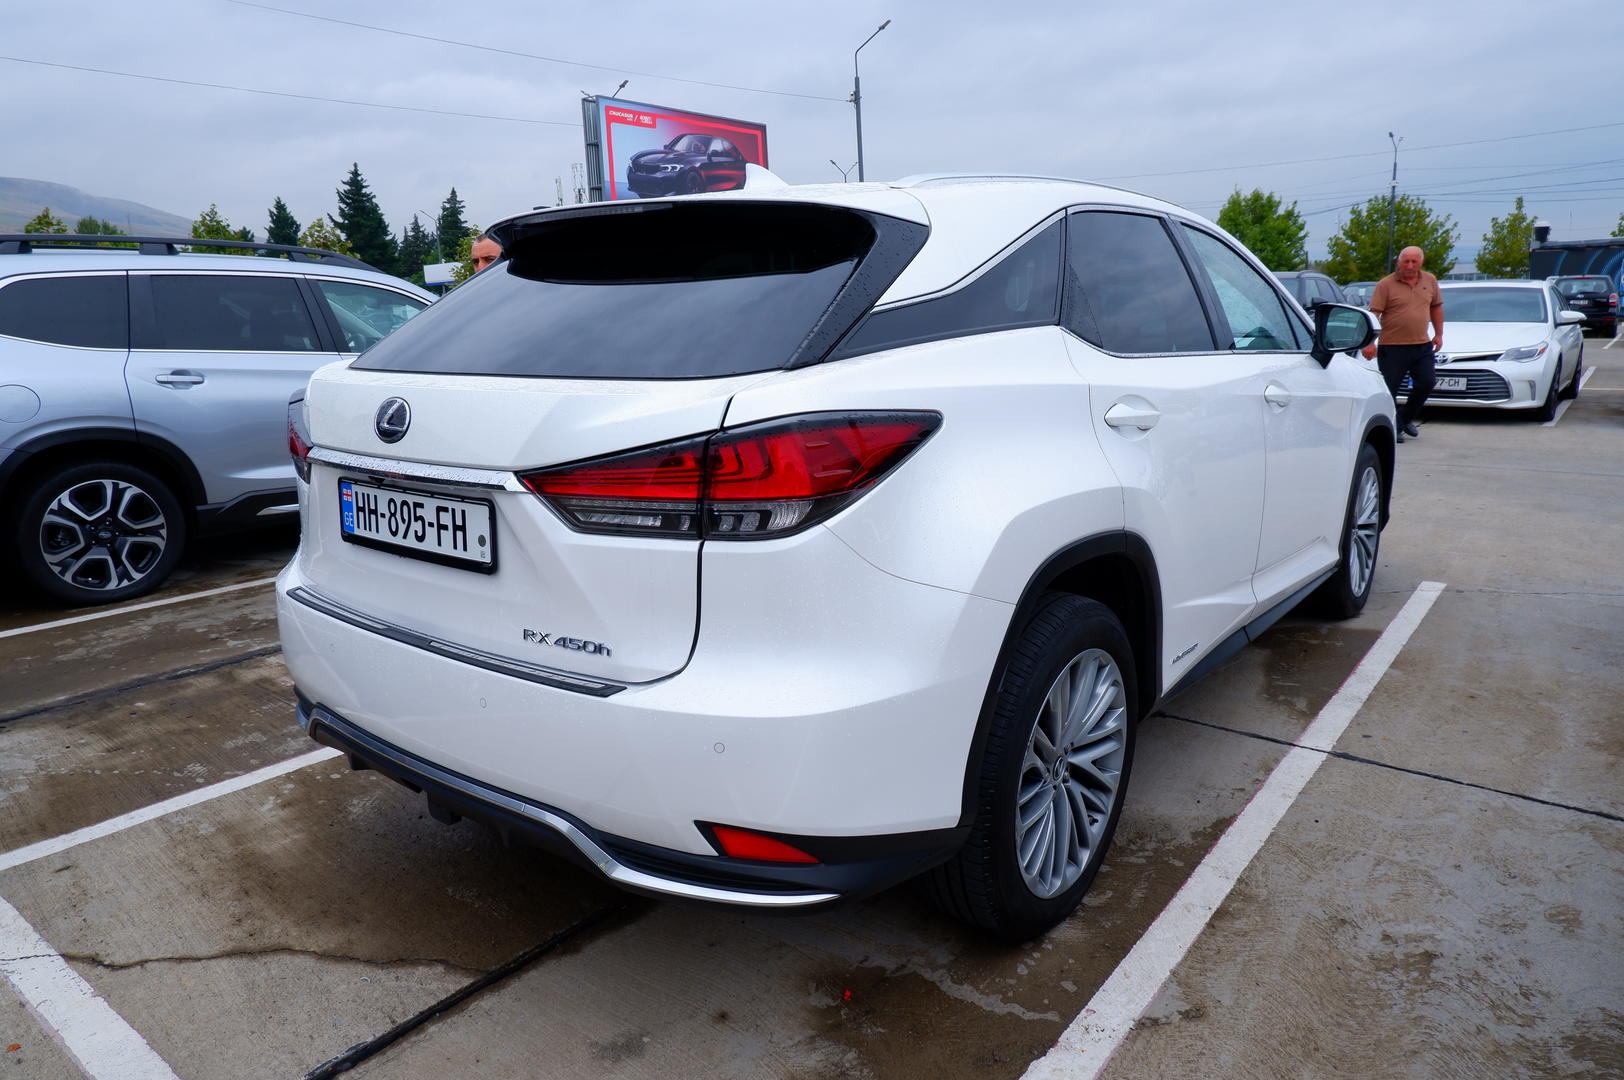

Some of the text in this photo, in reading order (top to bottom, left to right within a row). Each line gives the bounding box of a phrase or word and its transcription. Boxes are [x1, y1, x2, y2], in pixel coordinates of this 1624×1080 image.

[344, 511, 354, 527] GE
[354, 490, 468, 552] HH-895-FH
[523, 628, 612, 657] RX 450h
